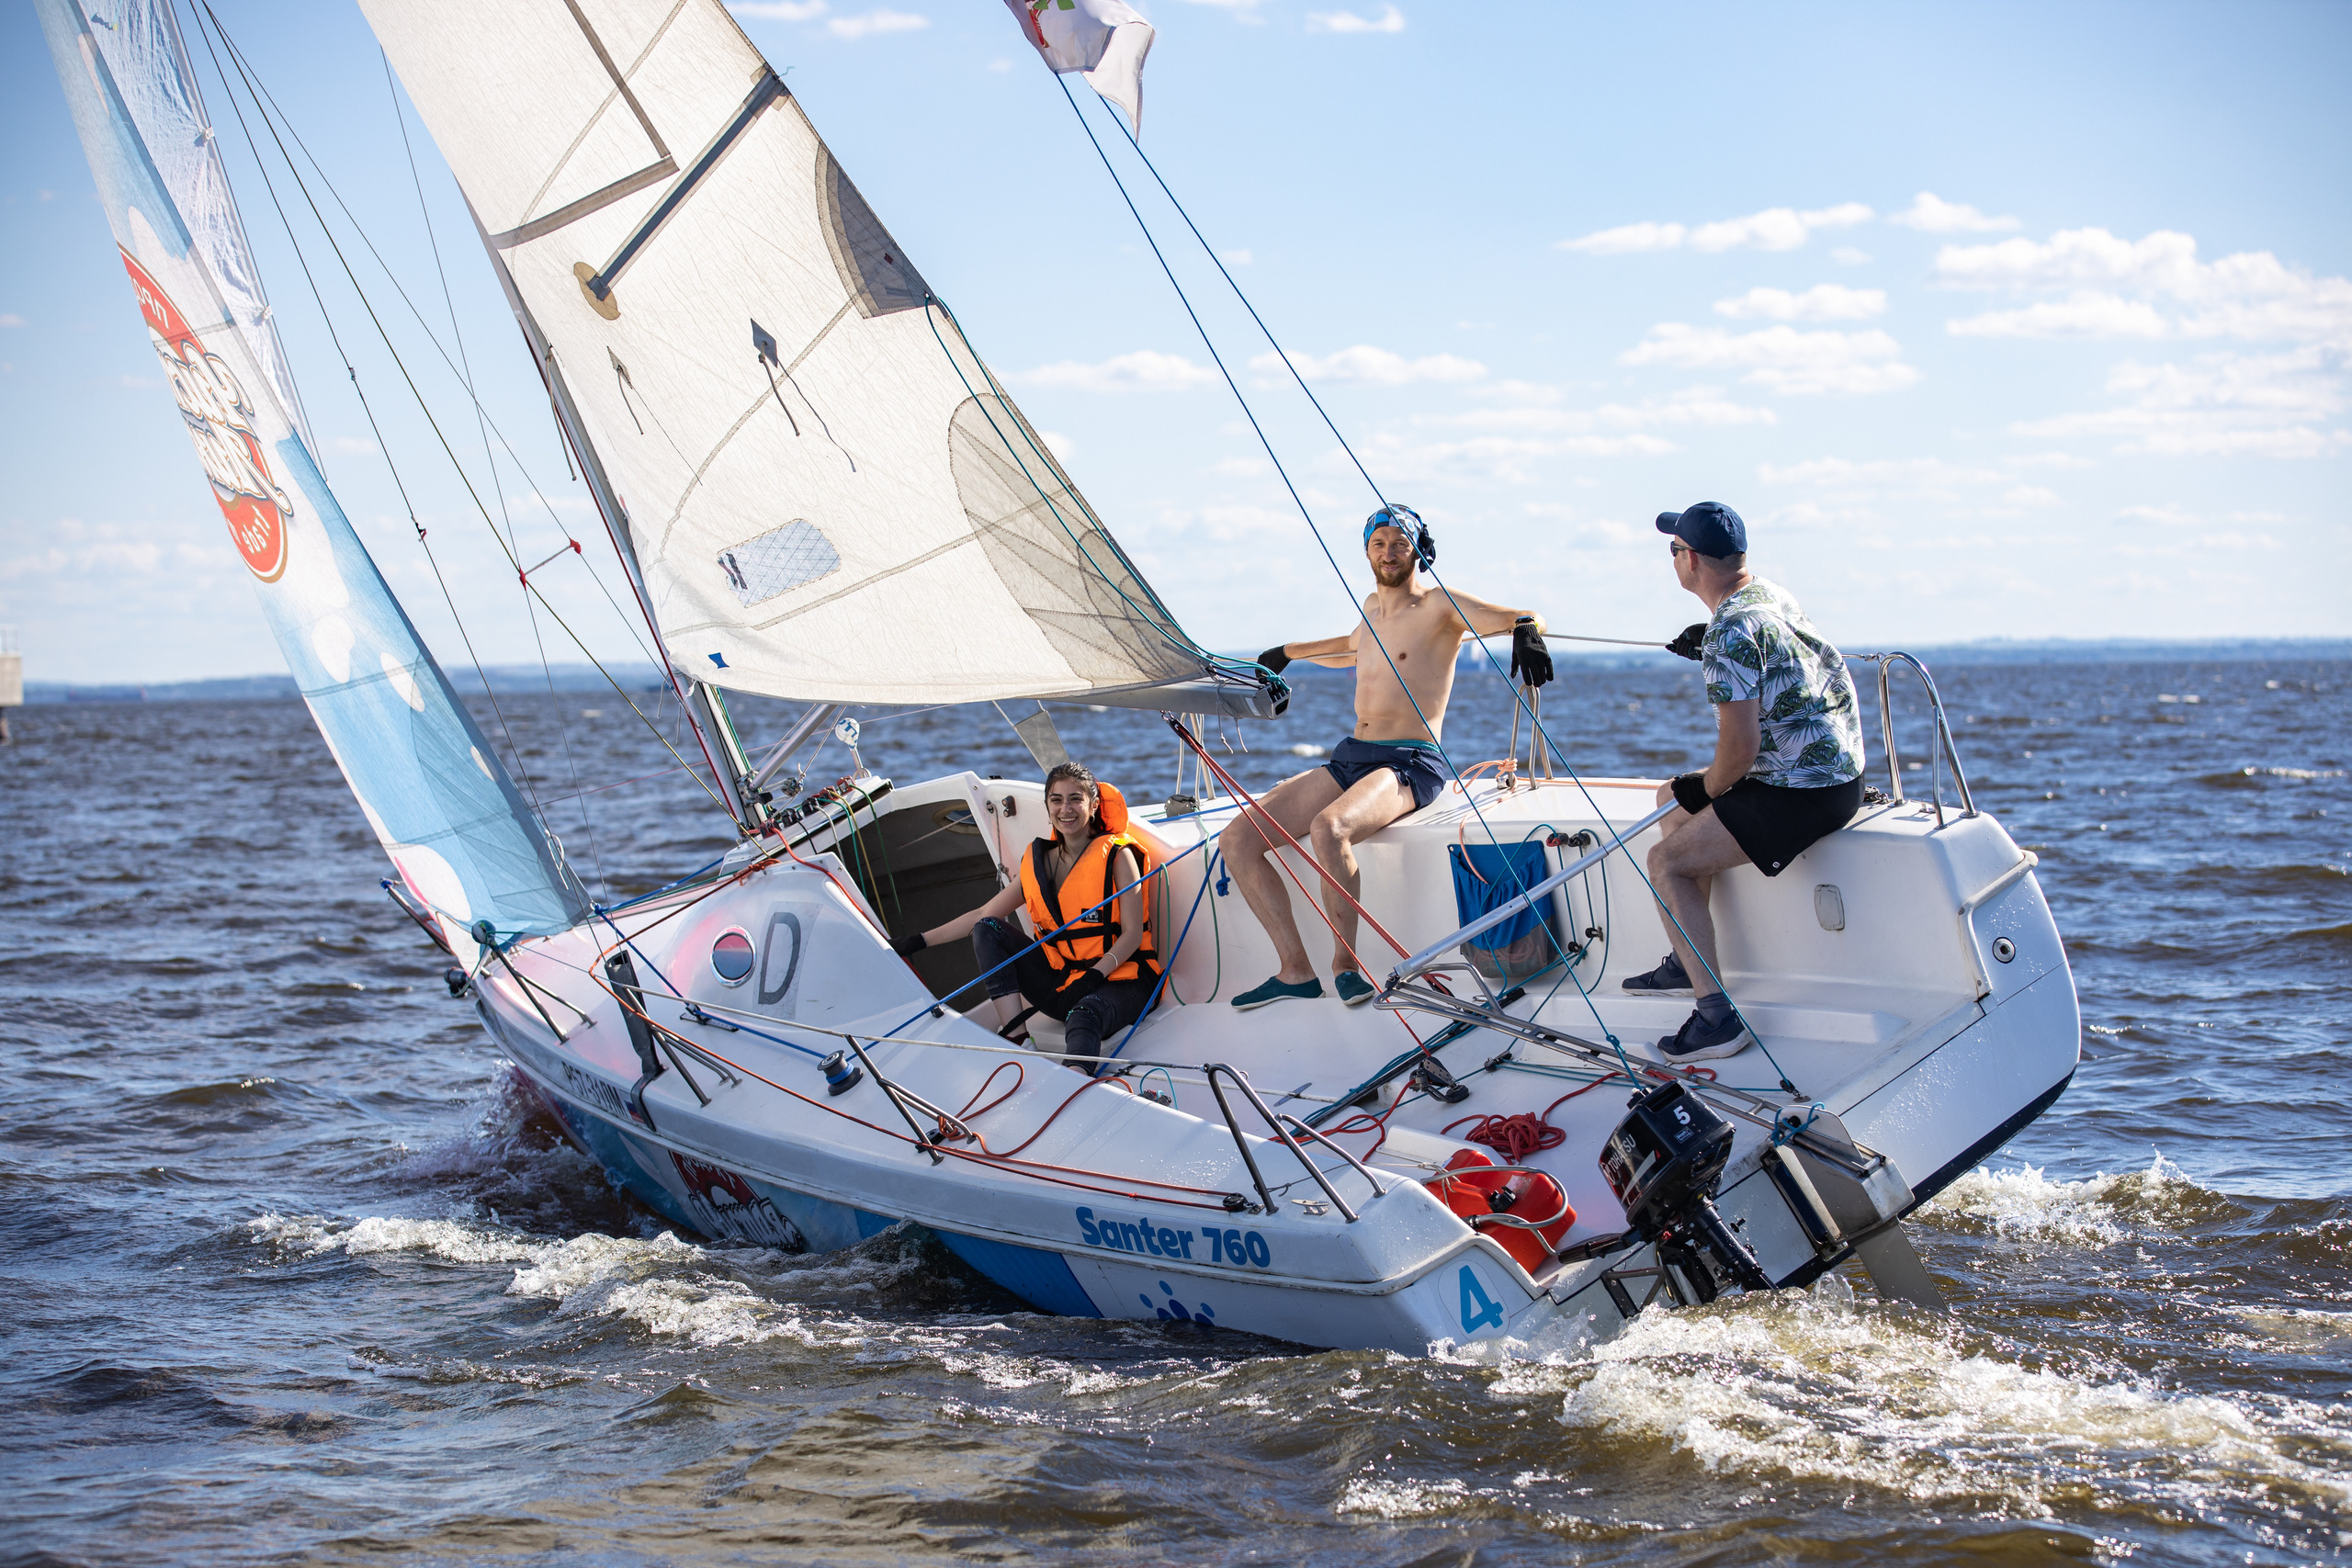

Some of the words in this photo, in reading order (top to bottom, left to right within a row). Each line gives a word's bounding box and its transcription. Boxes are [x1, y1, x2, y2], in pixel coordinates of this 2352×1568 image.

[758, 912, 801, 1005] D
[1673, 1105, 1690, 1125] 5
[1608, 1134, 1636, 1172] TOHATSU
[1076, 1206, 1194, 1259] Santer
[1202, 1227, 1271, 1268] 760
[1459, 1265, 1504, 1334] 4
